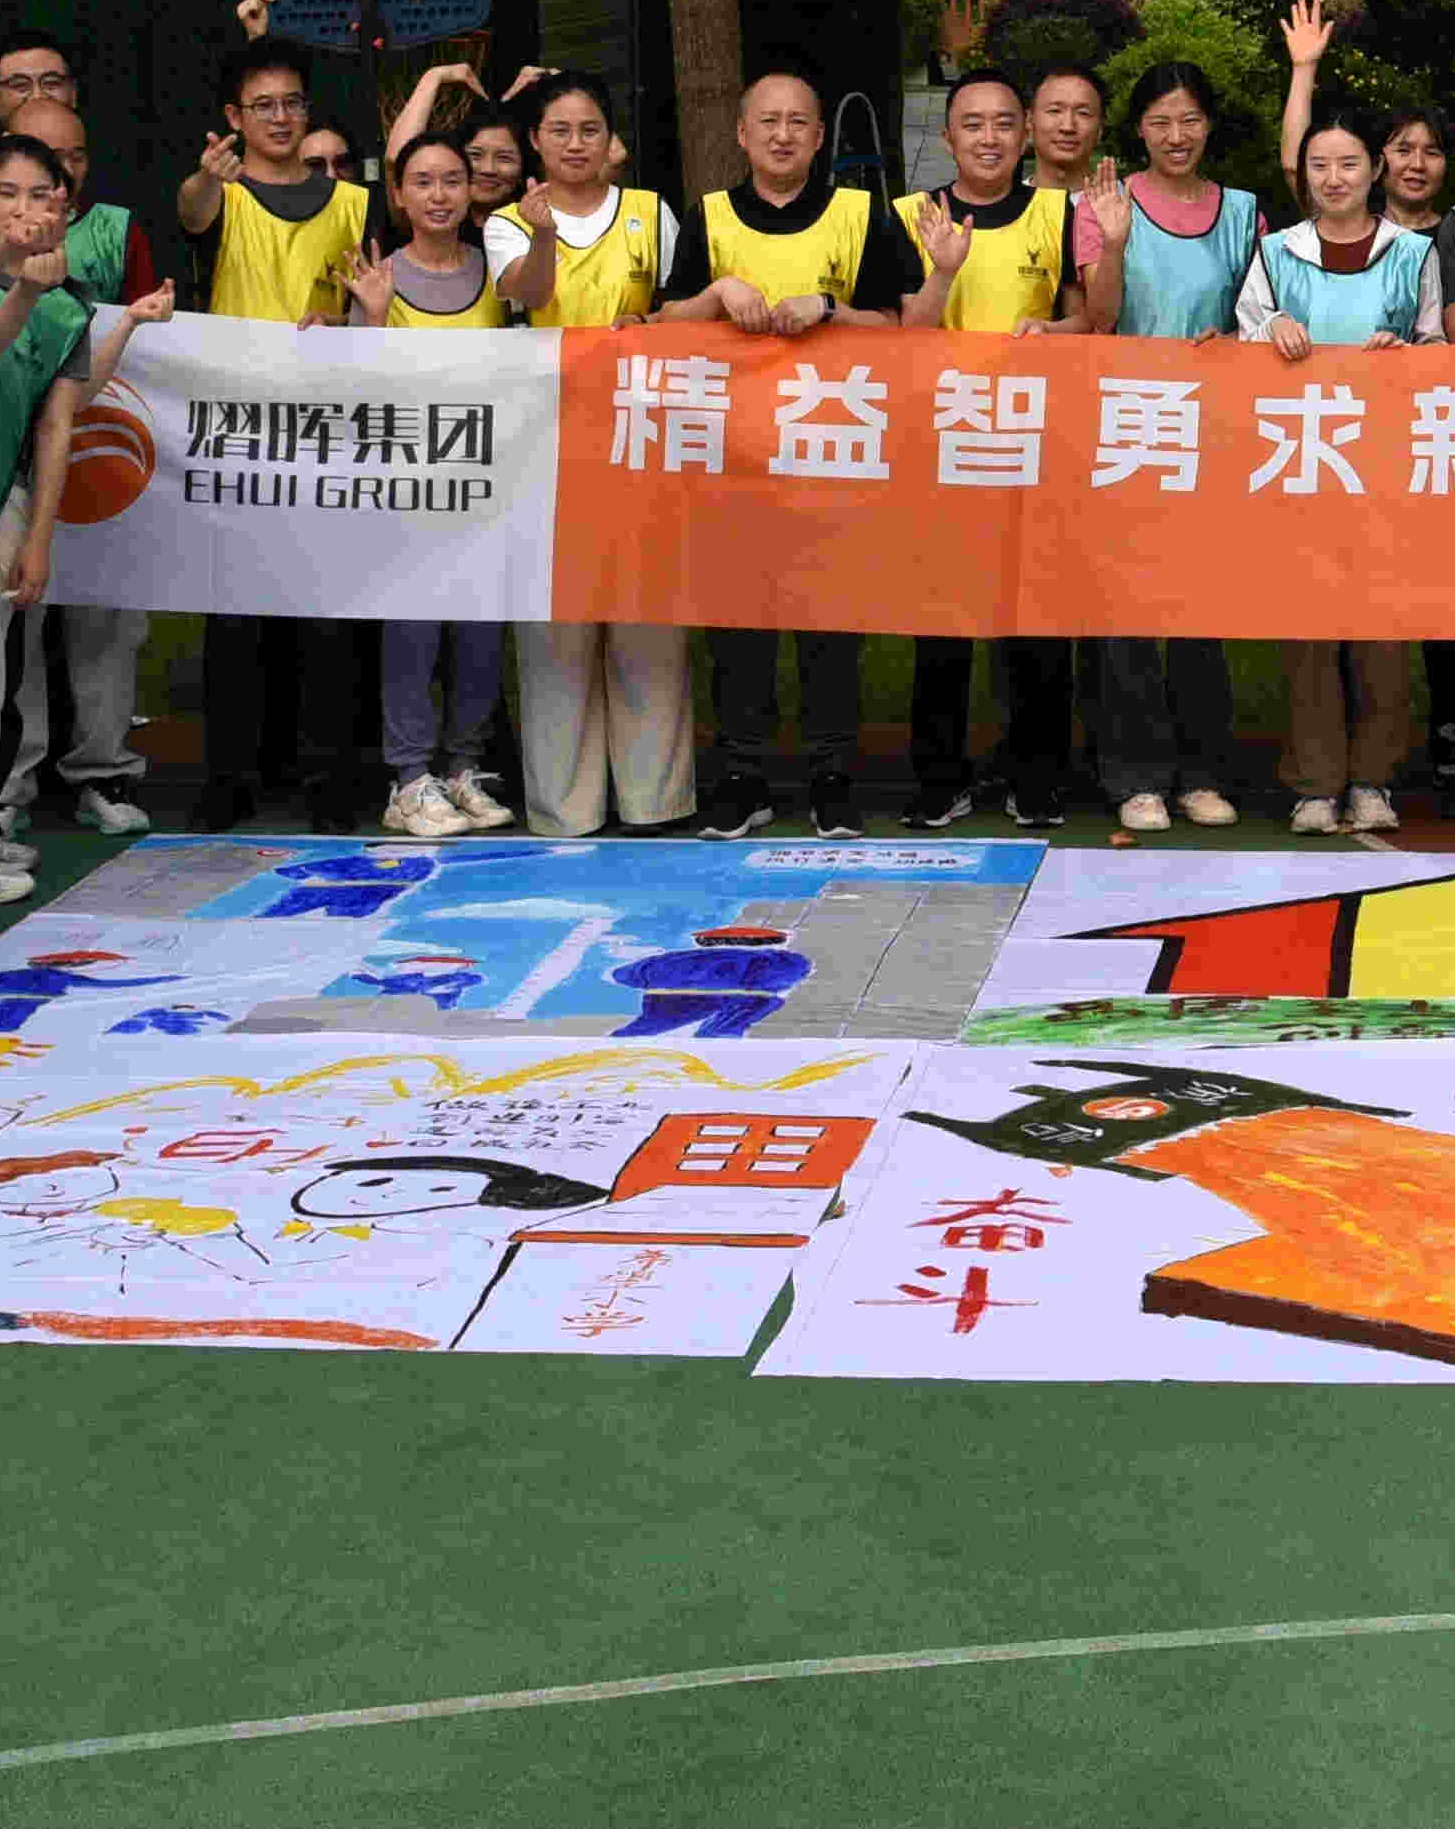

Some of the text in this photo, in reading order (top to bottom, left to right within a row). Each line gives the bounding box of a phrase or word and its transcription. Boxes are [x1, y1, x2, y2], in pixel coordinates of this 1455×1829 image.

[185, 399, 496, 470] 熠晖集团
[183, 474, 494, 514] EHUI GROUP
[853, 1188, 1074, 1335] 奋斗
